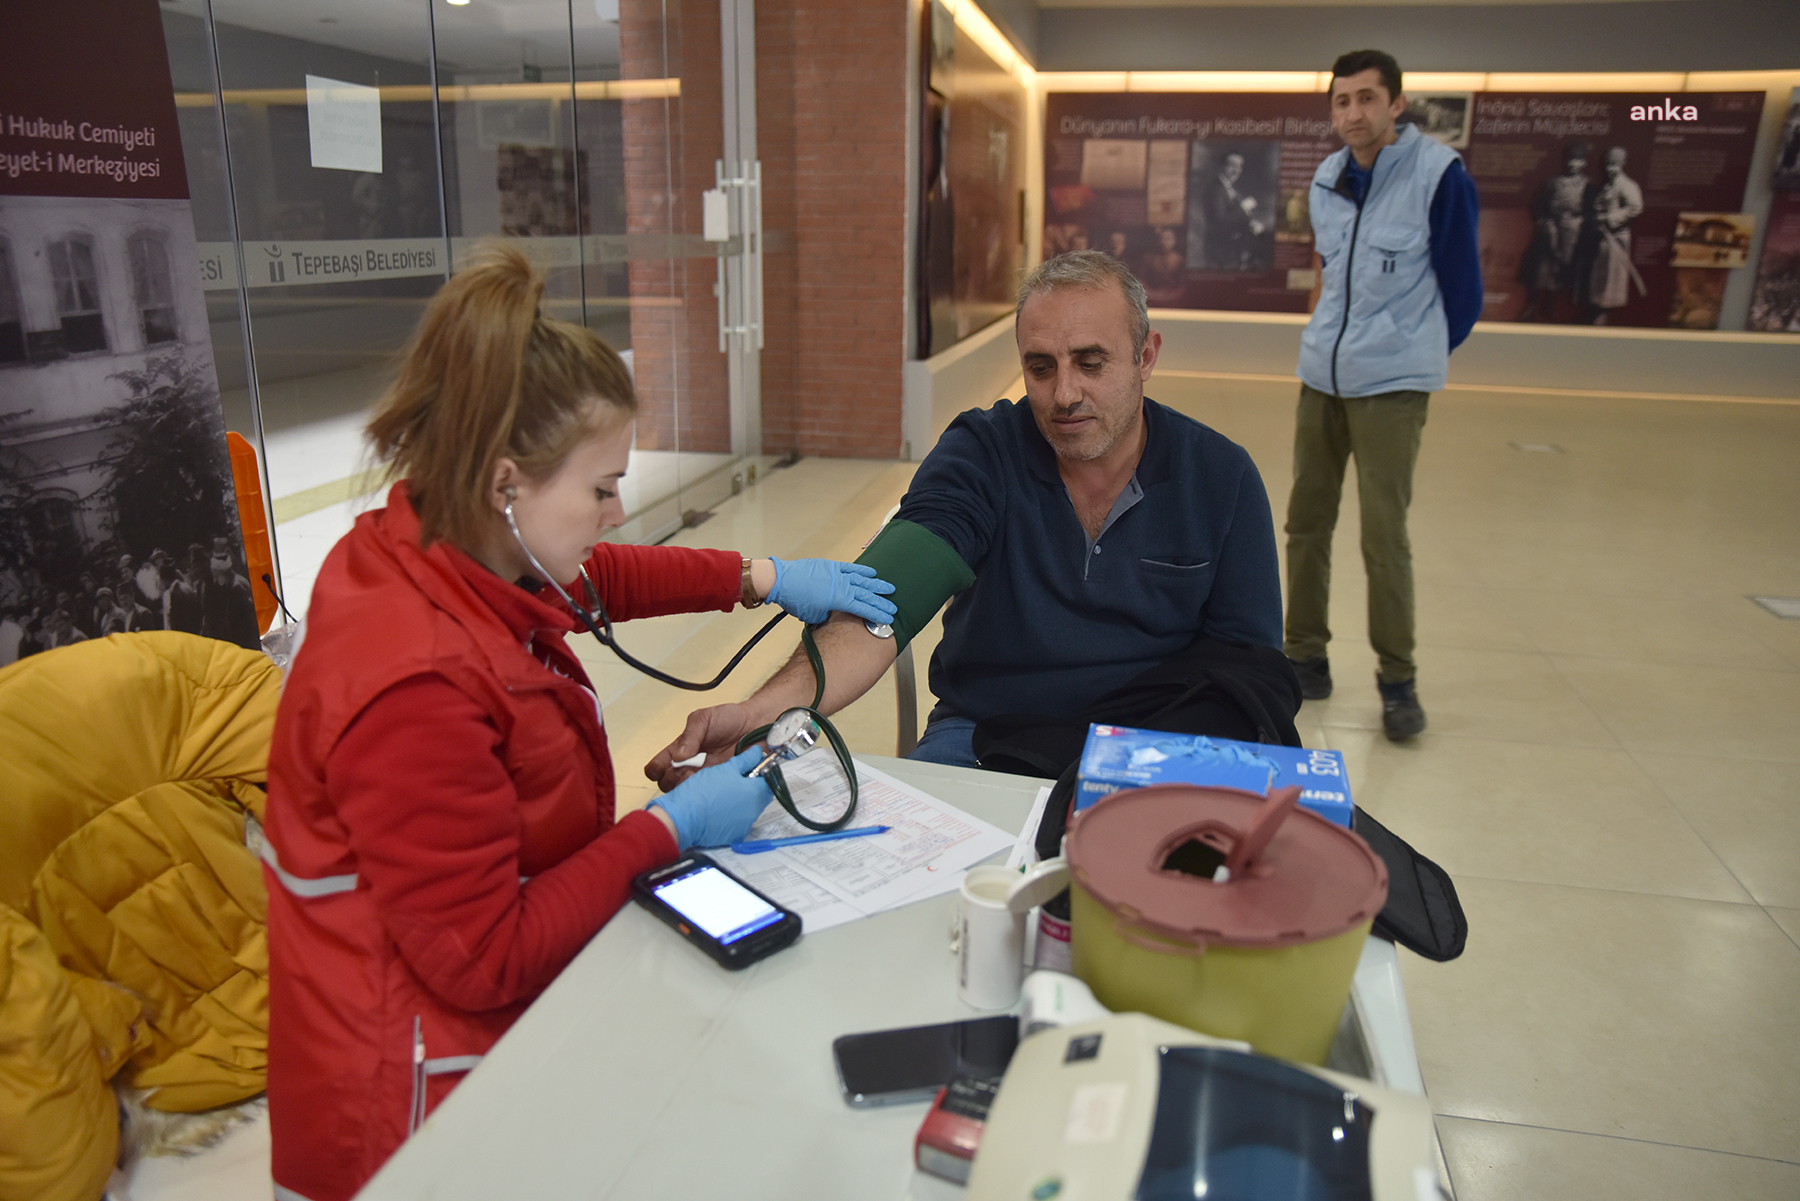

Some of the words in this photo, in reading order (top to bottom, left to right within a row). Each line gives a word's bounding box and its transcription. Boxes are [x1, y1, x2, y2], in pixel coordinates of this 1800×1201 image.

[8, 114, 75, 140] Hukuk
[79, 122, 156, 151] Cemiyeti
[58, 153, 161, 182] Merkeziyesi
[292, 251, 363, 277] TEPEBAŞI
[366, 248, 436, 271] BELEDİYESİ
[1308, 750, 1340, 777] 403
